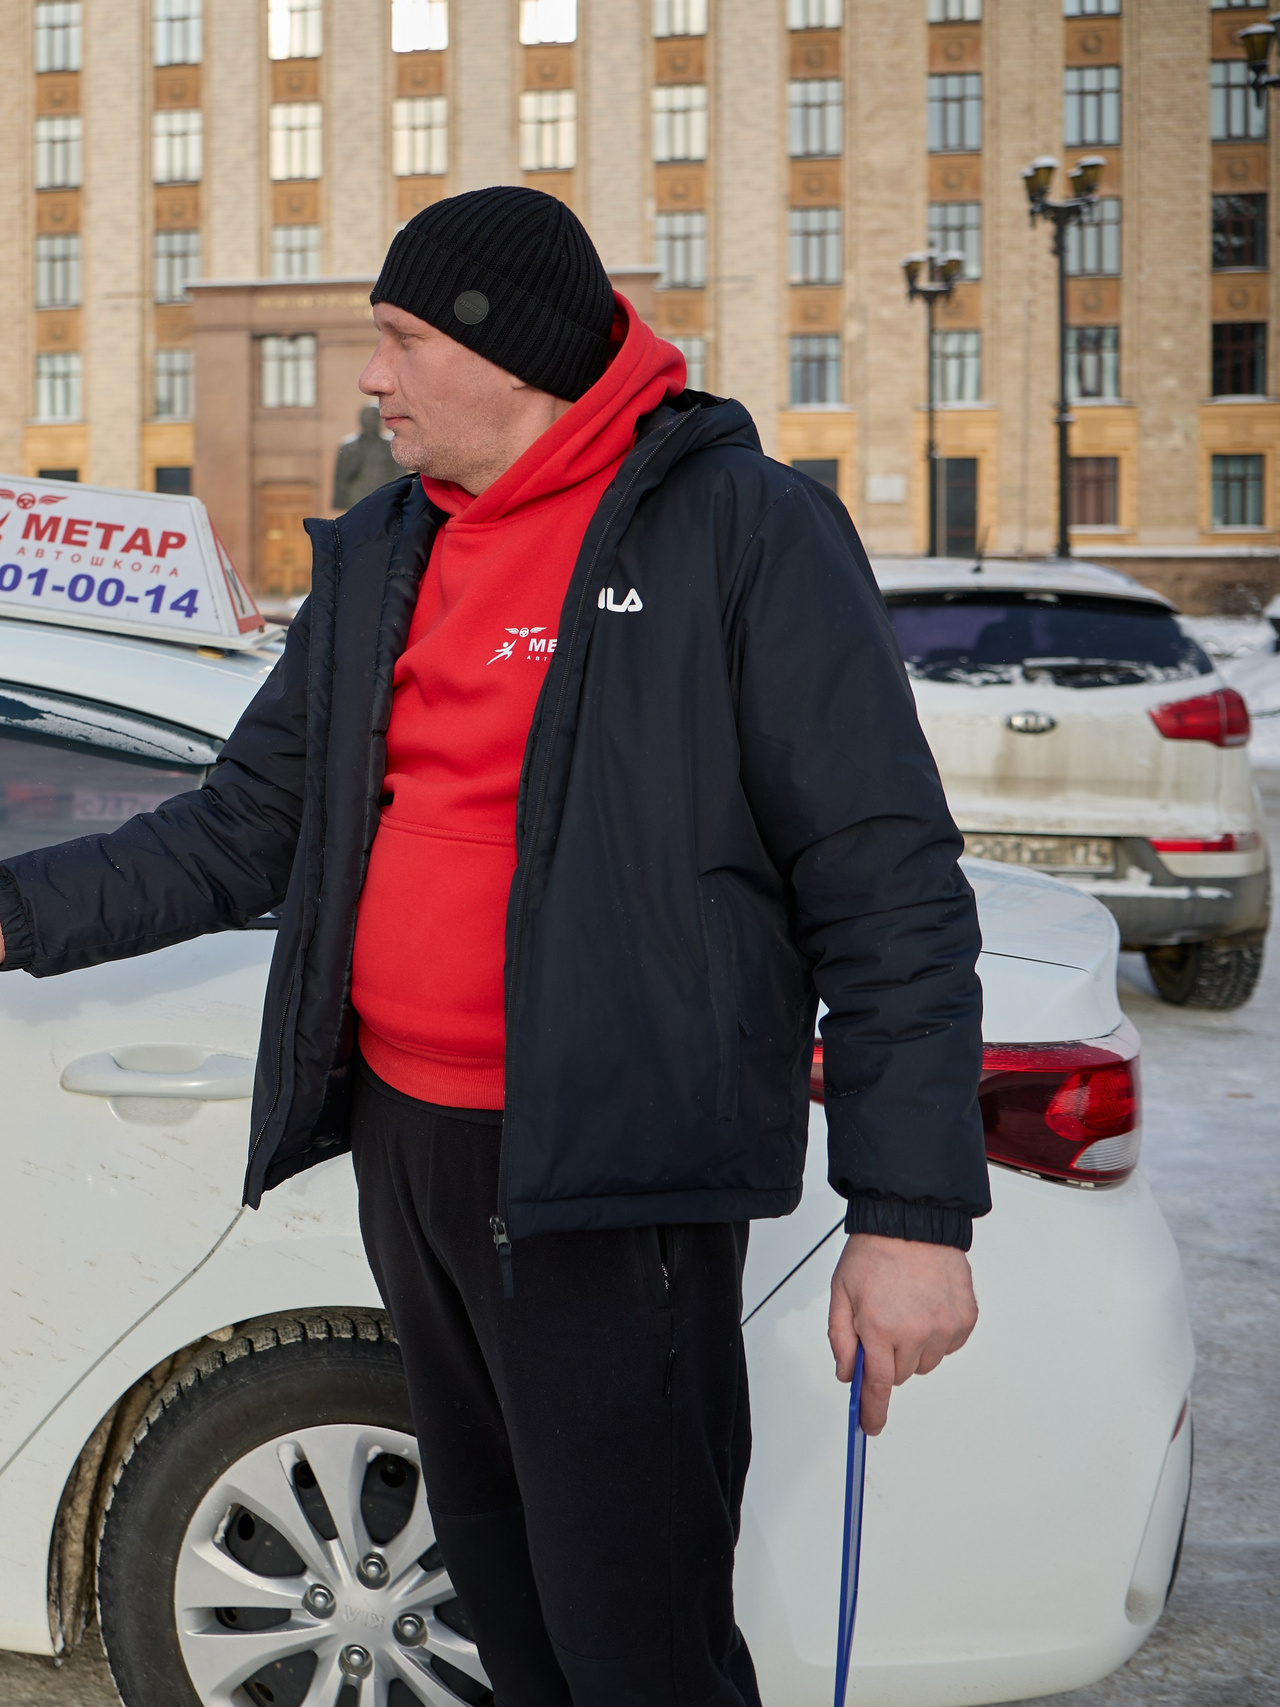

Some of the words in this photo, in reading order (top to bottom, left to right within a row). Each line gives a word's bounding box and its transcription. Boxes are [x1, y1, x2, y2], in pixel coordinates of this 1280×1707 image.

[459, 299, 483, 317] HUGO
[21, 513, 187, 558] МЕТАР
[16, 546, 179, 577] АВТОШКОЛА
[344, 1604, 385, 1631] KIA
